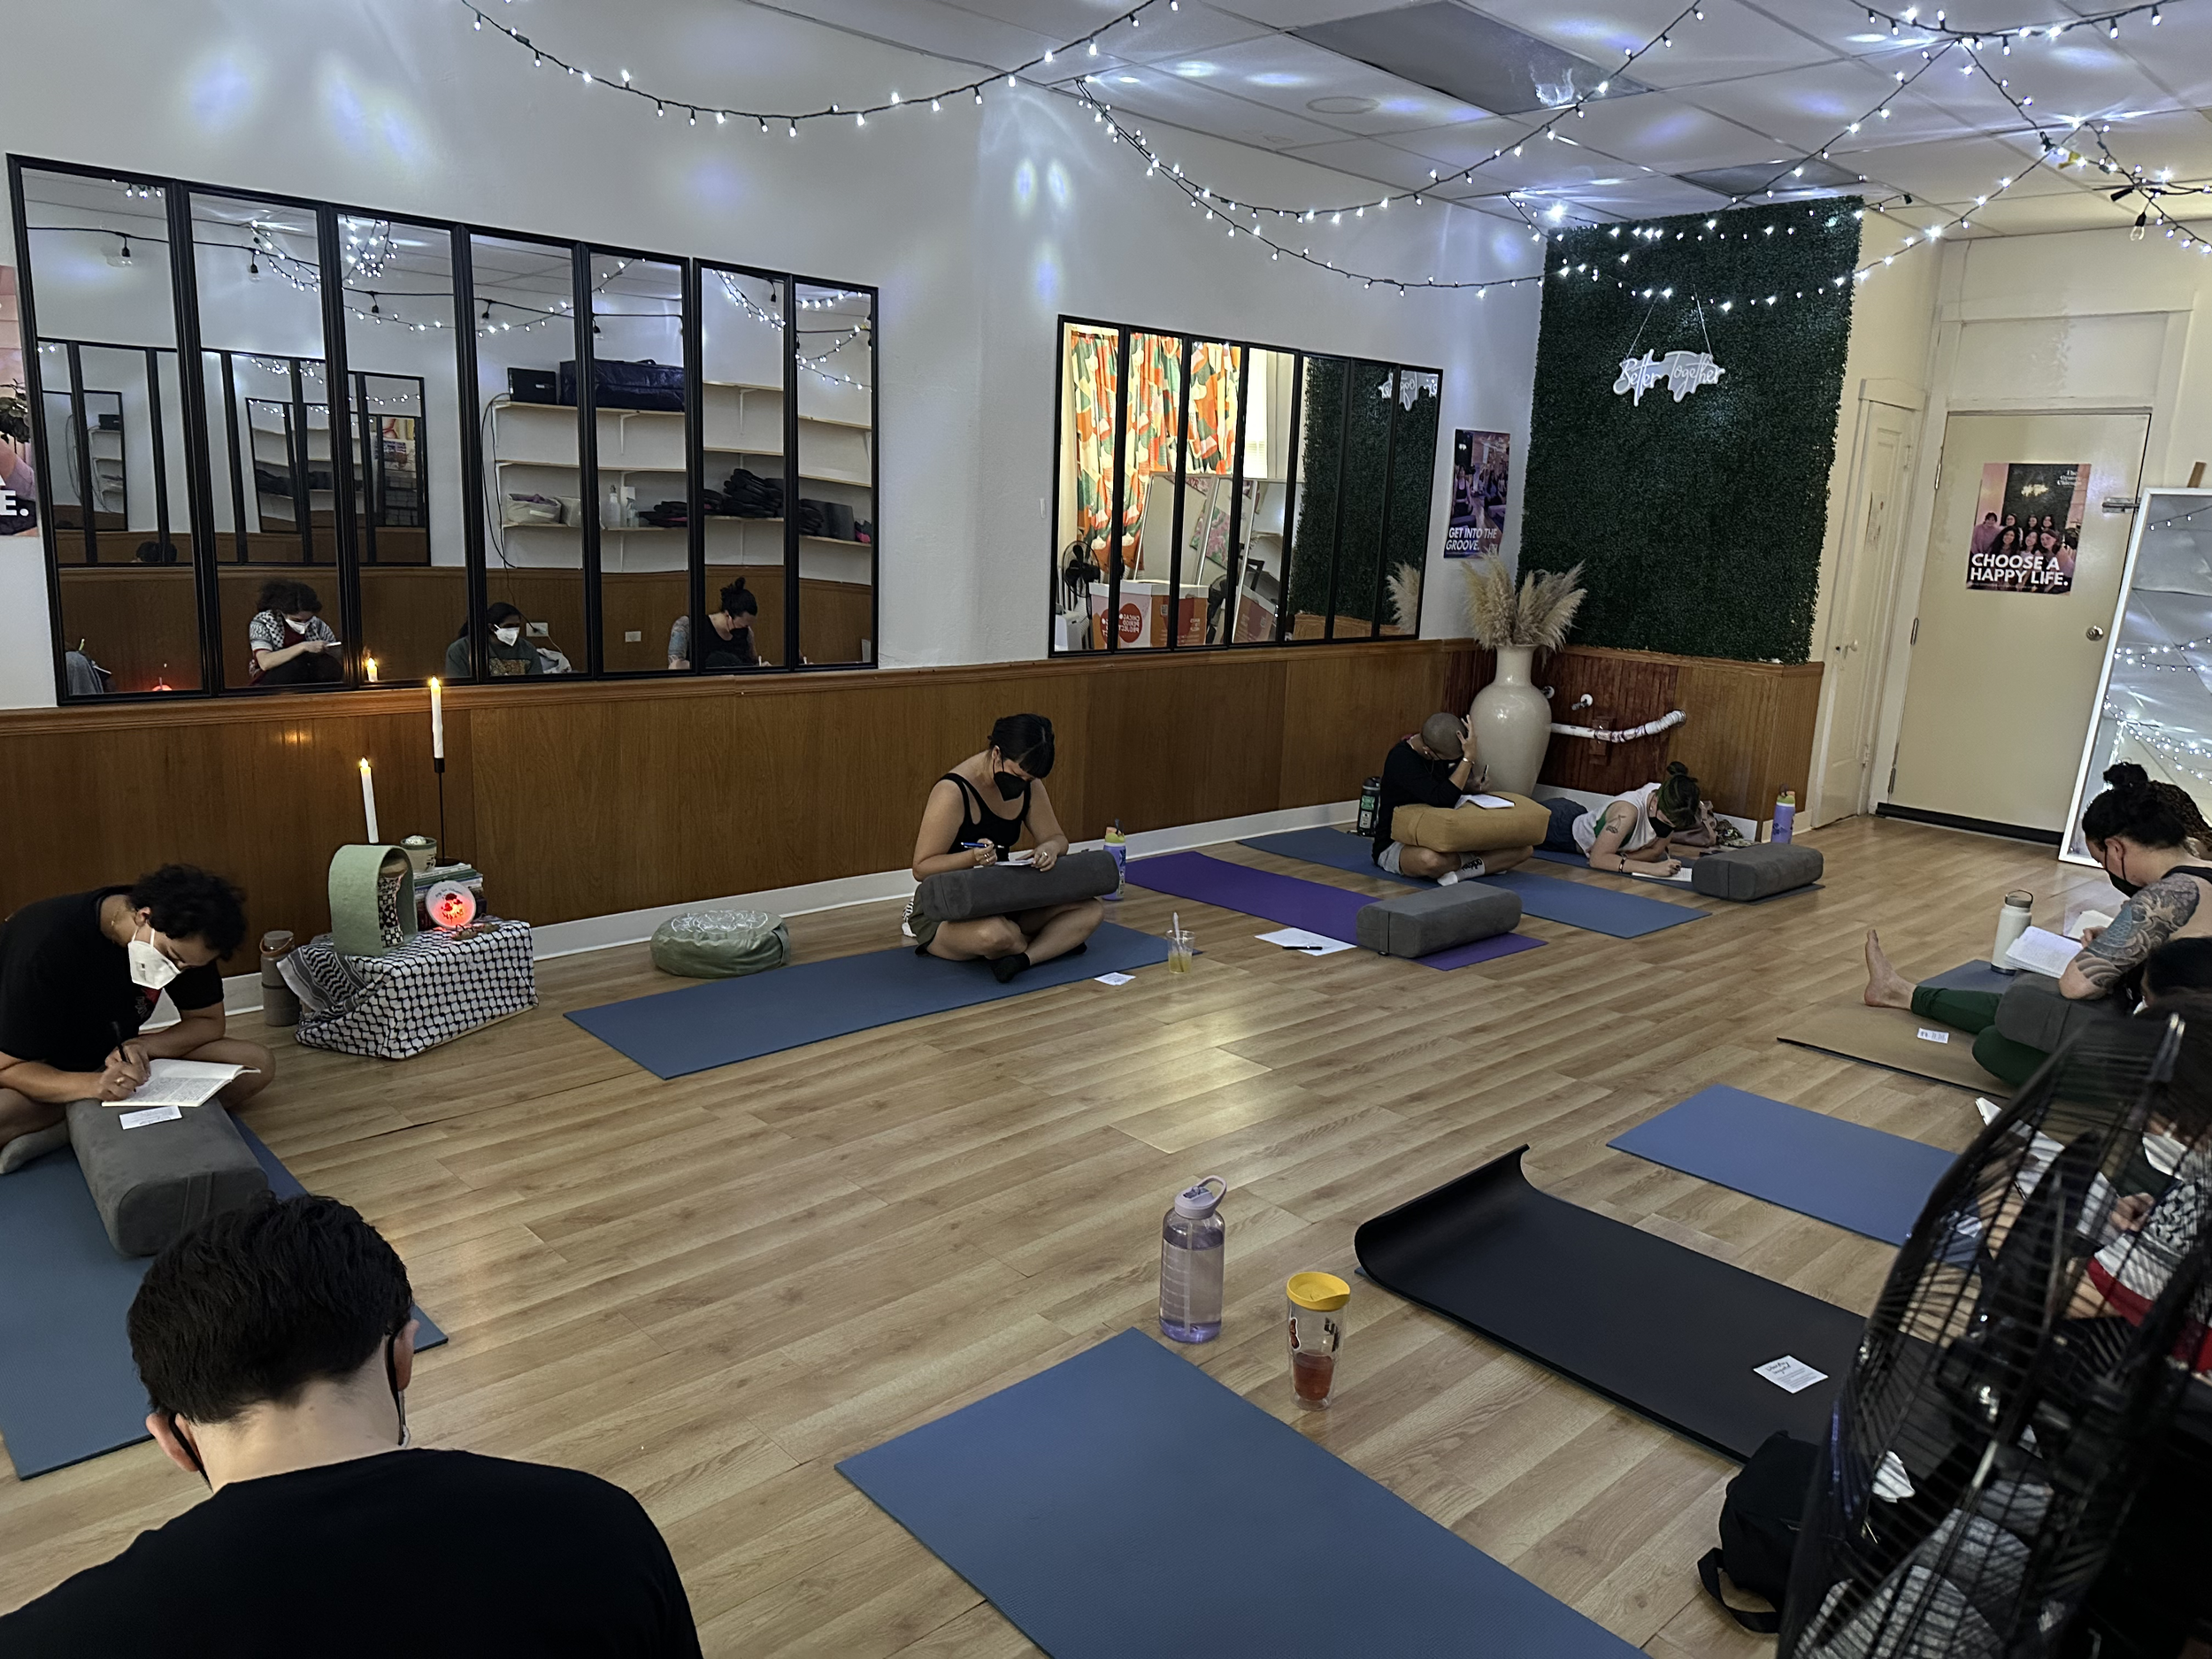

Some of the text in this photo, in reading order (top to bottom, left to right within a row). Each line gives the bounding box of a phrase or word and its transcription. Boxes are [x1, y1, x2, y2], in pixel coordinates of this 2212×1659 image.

[1613, 349, 1725, 407] Better Together
[1449, 527, 1497, 539] GET INTO THE
[1446, 540, 1479, 550] GROOVE.
[1971, 553, 2060, 571] CHOOSE A
[1970, 567, 2027, 583] HAPPY
[2031, 571, 2069, 586] LIFE.
